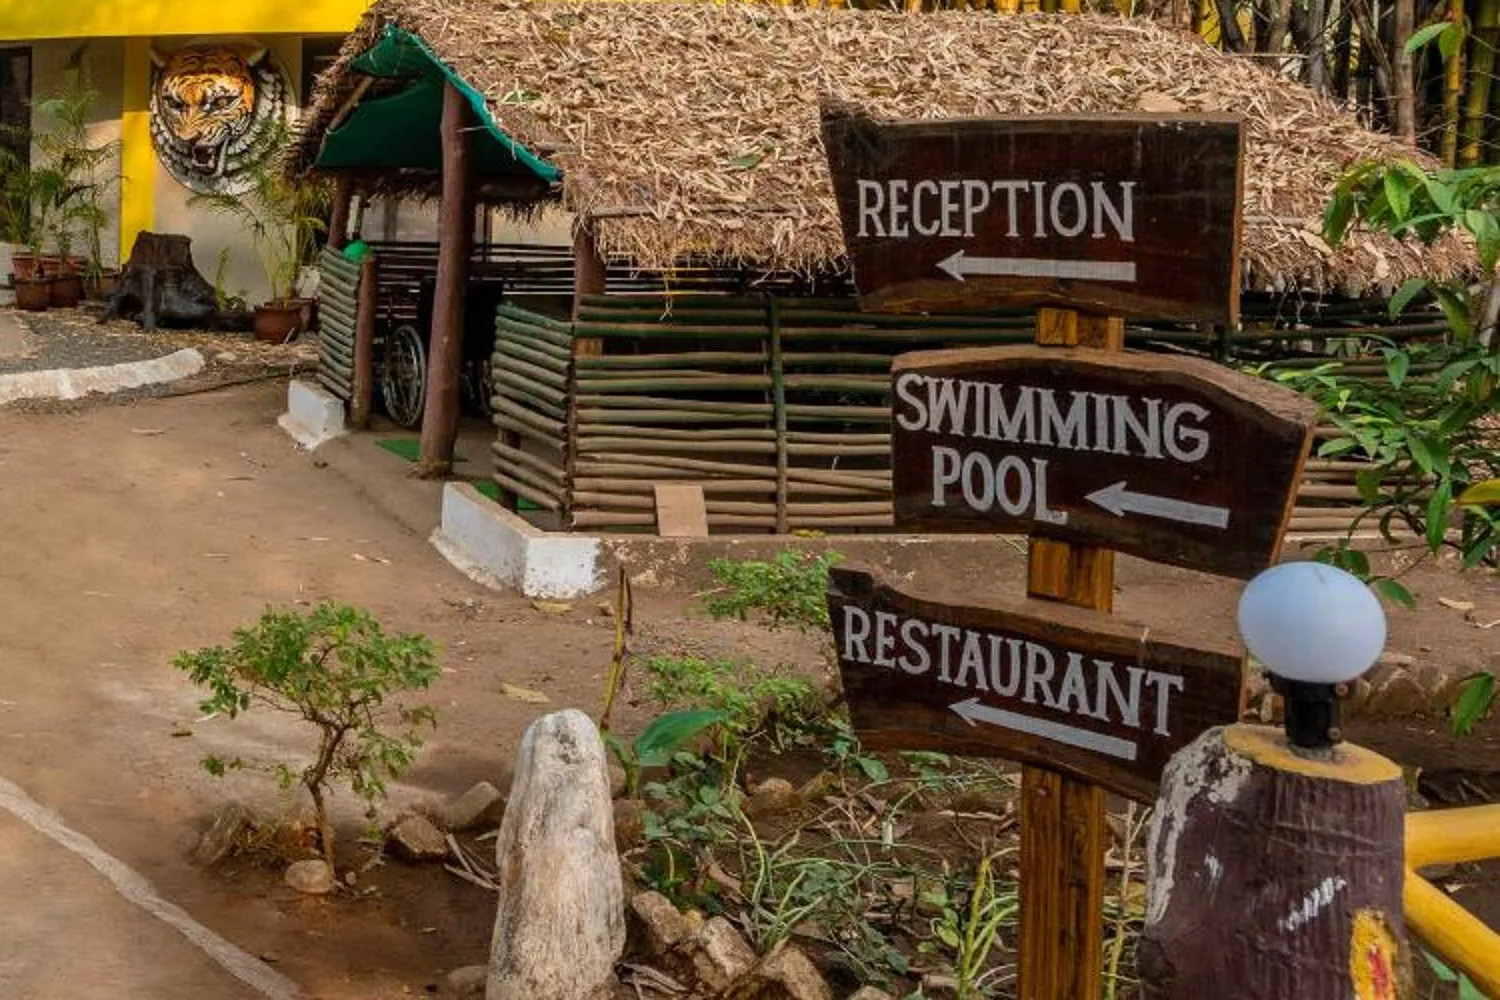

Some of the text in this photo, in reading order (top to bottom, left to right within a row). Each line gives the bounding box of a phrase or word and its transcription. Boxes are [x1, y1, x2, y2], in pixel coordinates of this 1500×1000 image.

[856, 179, 1136, 243] RECEPTION
[896, 373, 1211, 462] SWIMMING
[931, 446, 1068, 525] POOL
[842, 605, 1184, 737] RESTAURANT
